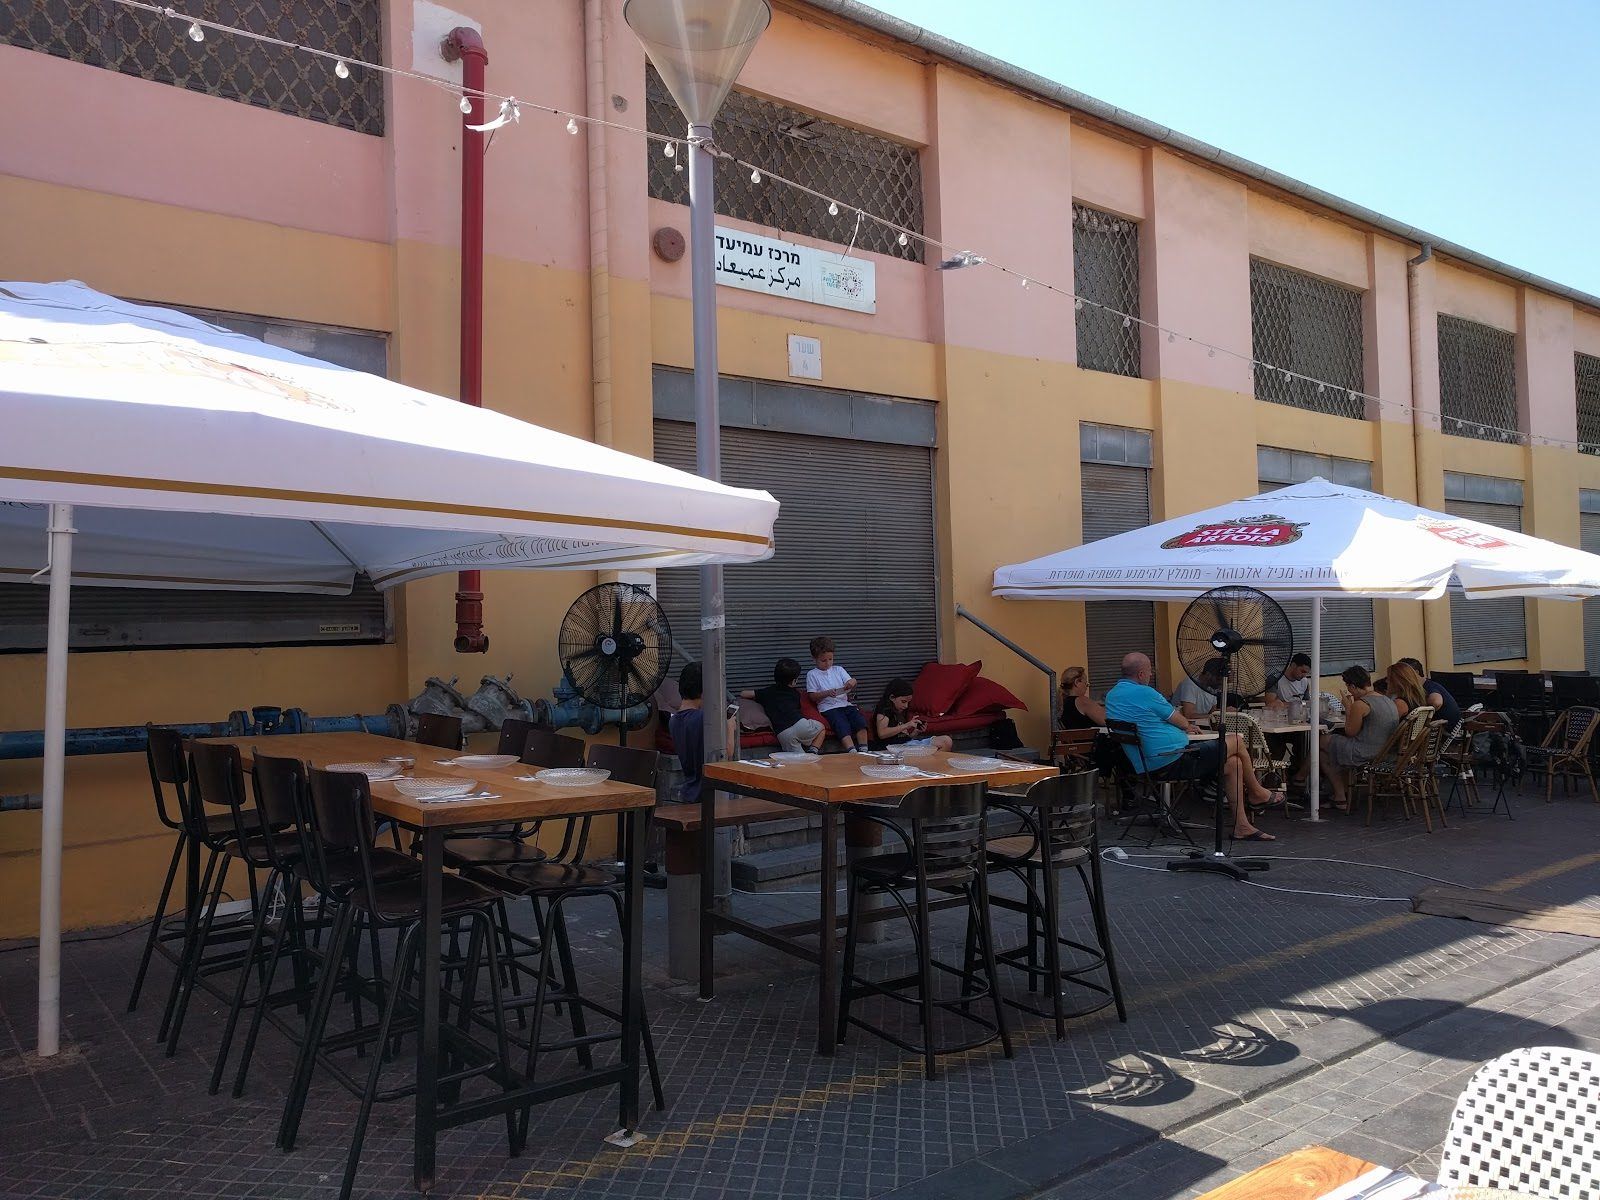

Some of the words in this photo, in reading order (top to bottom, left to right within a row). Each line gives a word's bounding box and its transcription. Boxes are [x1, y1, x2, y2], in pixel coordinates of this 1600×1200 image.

[715, 235, 763, 256] עמיעד
[768, 247, 800, 265] מרכז
[716, 254, 766, 281] عميعاد
[768, 266, 801, 291] مركز
[1198, 526, 1280, 537] STELLA
[1185, 534, 1275, 544] ARTOIS
[1088, 569, 1122, 579] משתיה
[1125, 567, 1164, 579] להימנע
[1167, 568, 1201, 580] מומלץ
[1216, 566, 1262, 580] אלכוהול
[1267, 566, 1294, 579] מכיל
